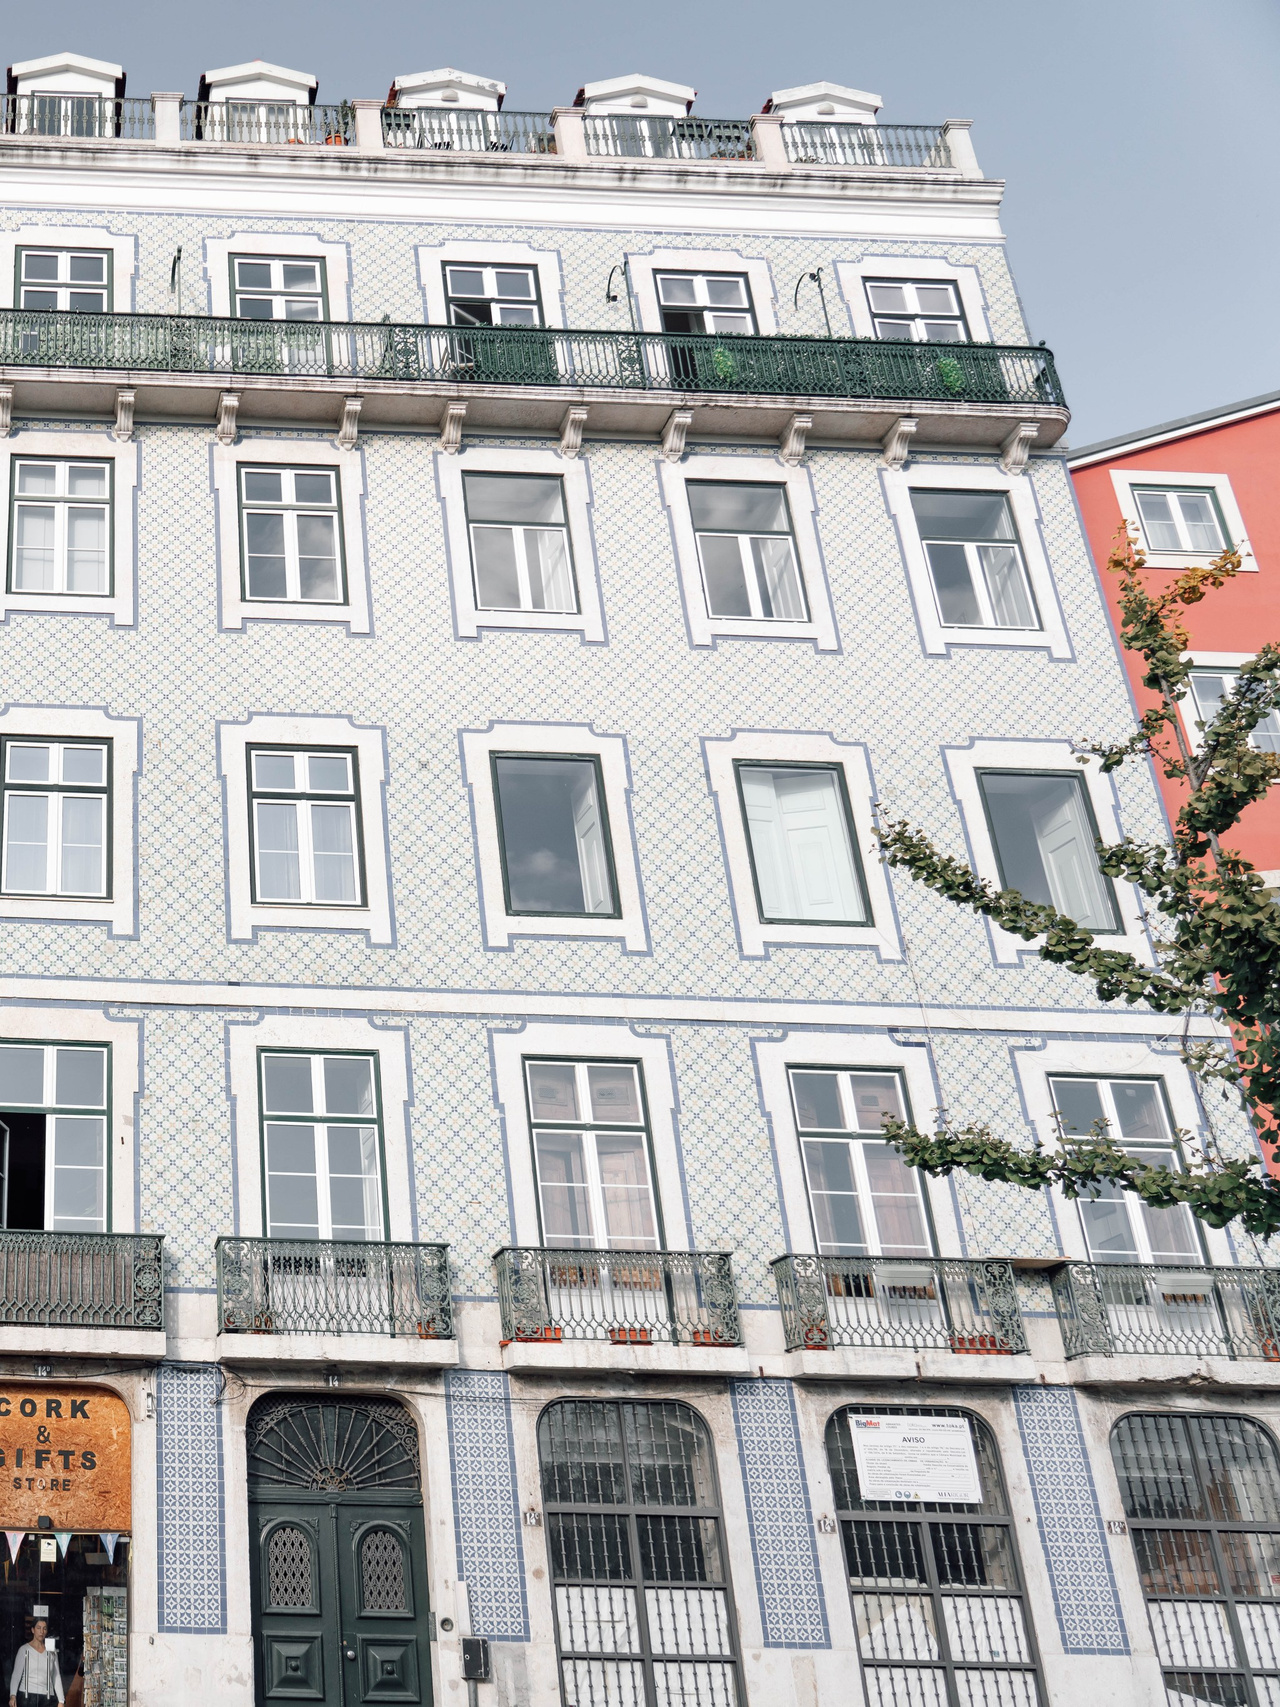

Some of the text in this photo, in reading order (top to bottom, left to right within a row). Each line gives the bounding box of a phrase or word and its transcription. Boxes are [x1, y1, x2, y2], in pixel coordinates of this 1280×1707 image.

[38, 1365, 51, 1377] 14D
[328, 1375, 339, 1387] 14
[855, 1419, 881, 1429] BigMat
[36, 1425, 52, 1444] &
[902, 1436, 926, 1444] AVISO
[12, 1477, 71, 1491] STORE
